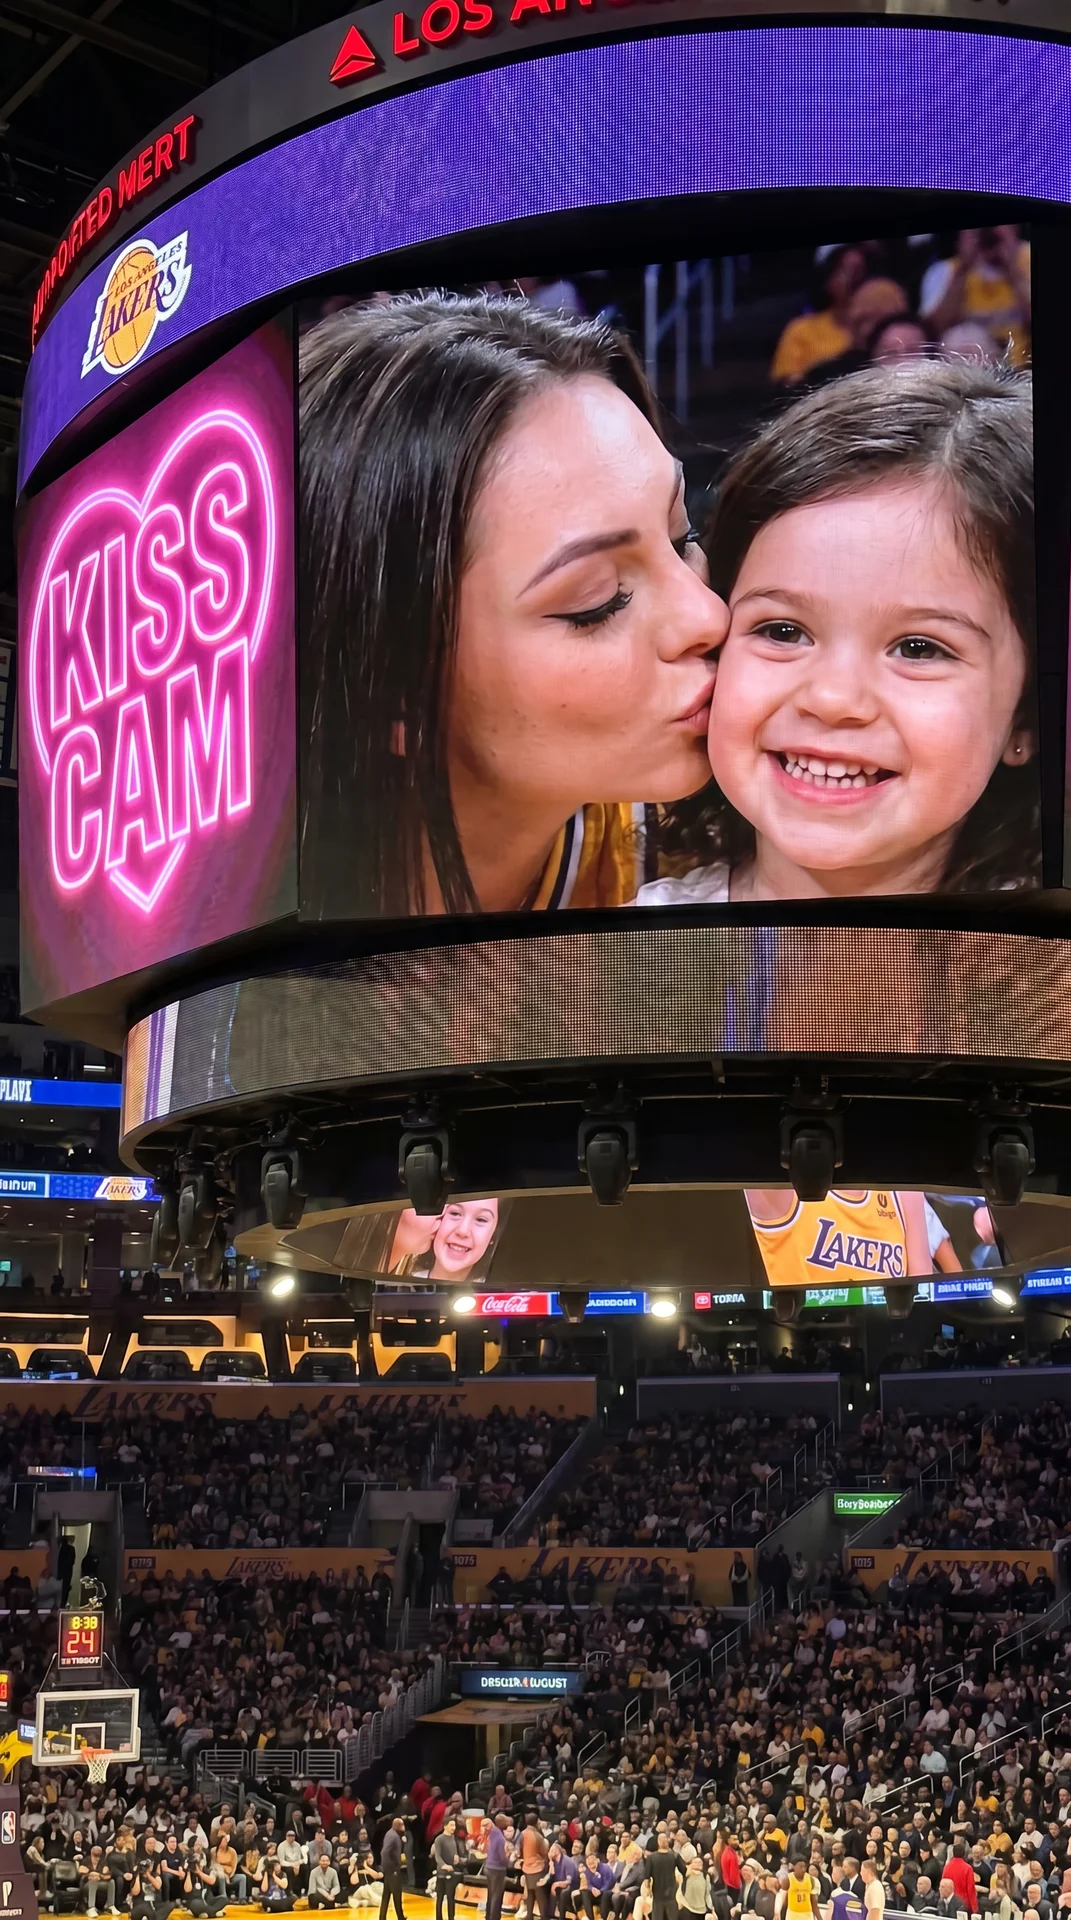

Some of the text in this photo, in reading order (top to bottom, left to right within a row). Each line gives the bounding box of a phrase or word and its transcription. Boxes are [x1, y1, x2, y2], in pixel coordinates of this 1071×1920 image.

[394, 0, 493, 55] LOS
[118, 115, 194, 208] MERT
[115, 241, 183, 298] LOS ANGELES
[84, 259, 182, 363] LAKERS
[49, 461, 250, 730] KISS
[50, 636, 252, 890] CAM
[101, 1182, 142, 1195] LAKERS
[806, 1217, 904, 1278] LAKERS
[225, 1556, 284, 1578] LAKERS
[67, 1631, 94, 1654] 24
[72, 1616, 98, 1630] 8:38
[71, 1656, 100, 1665] TISSOT
